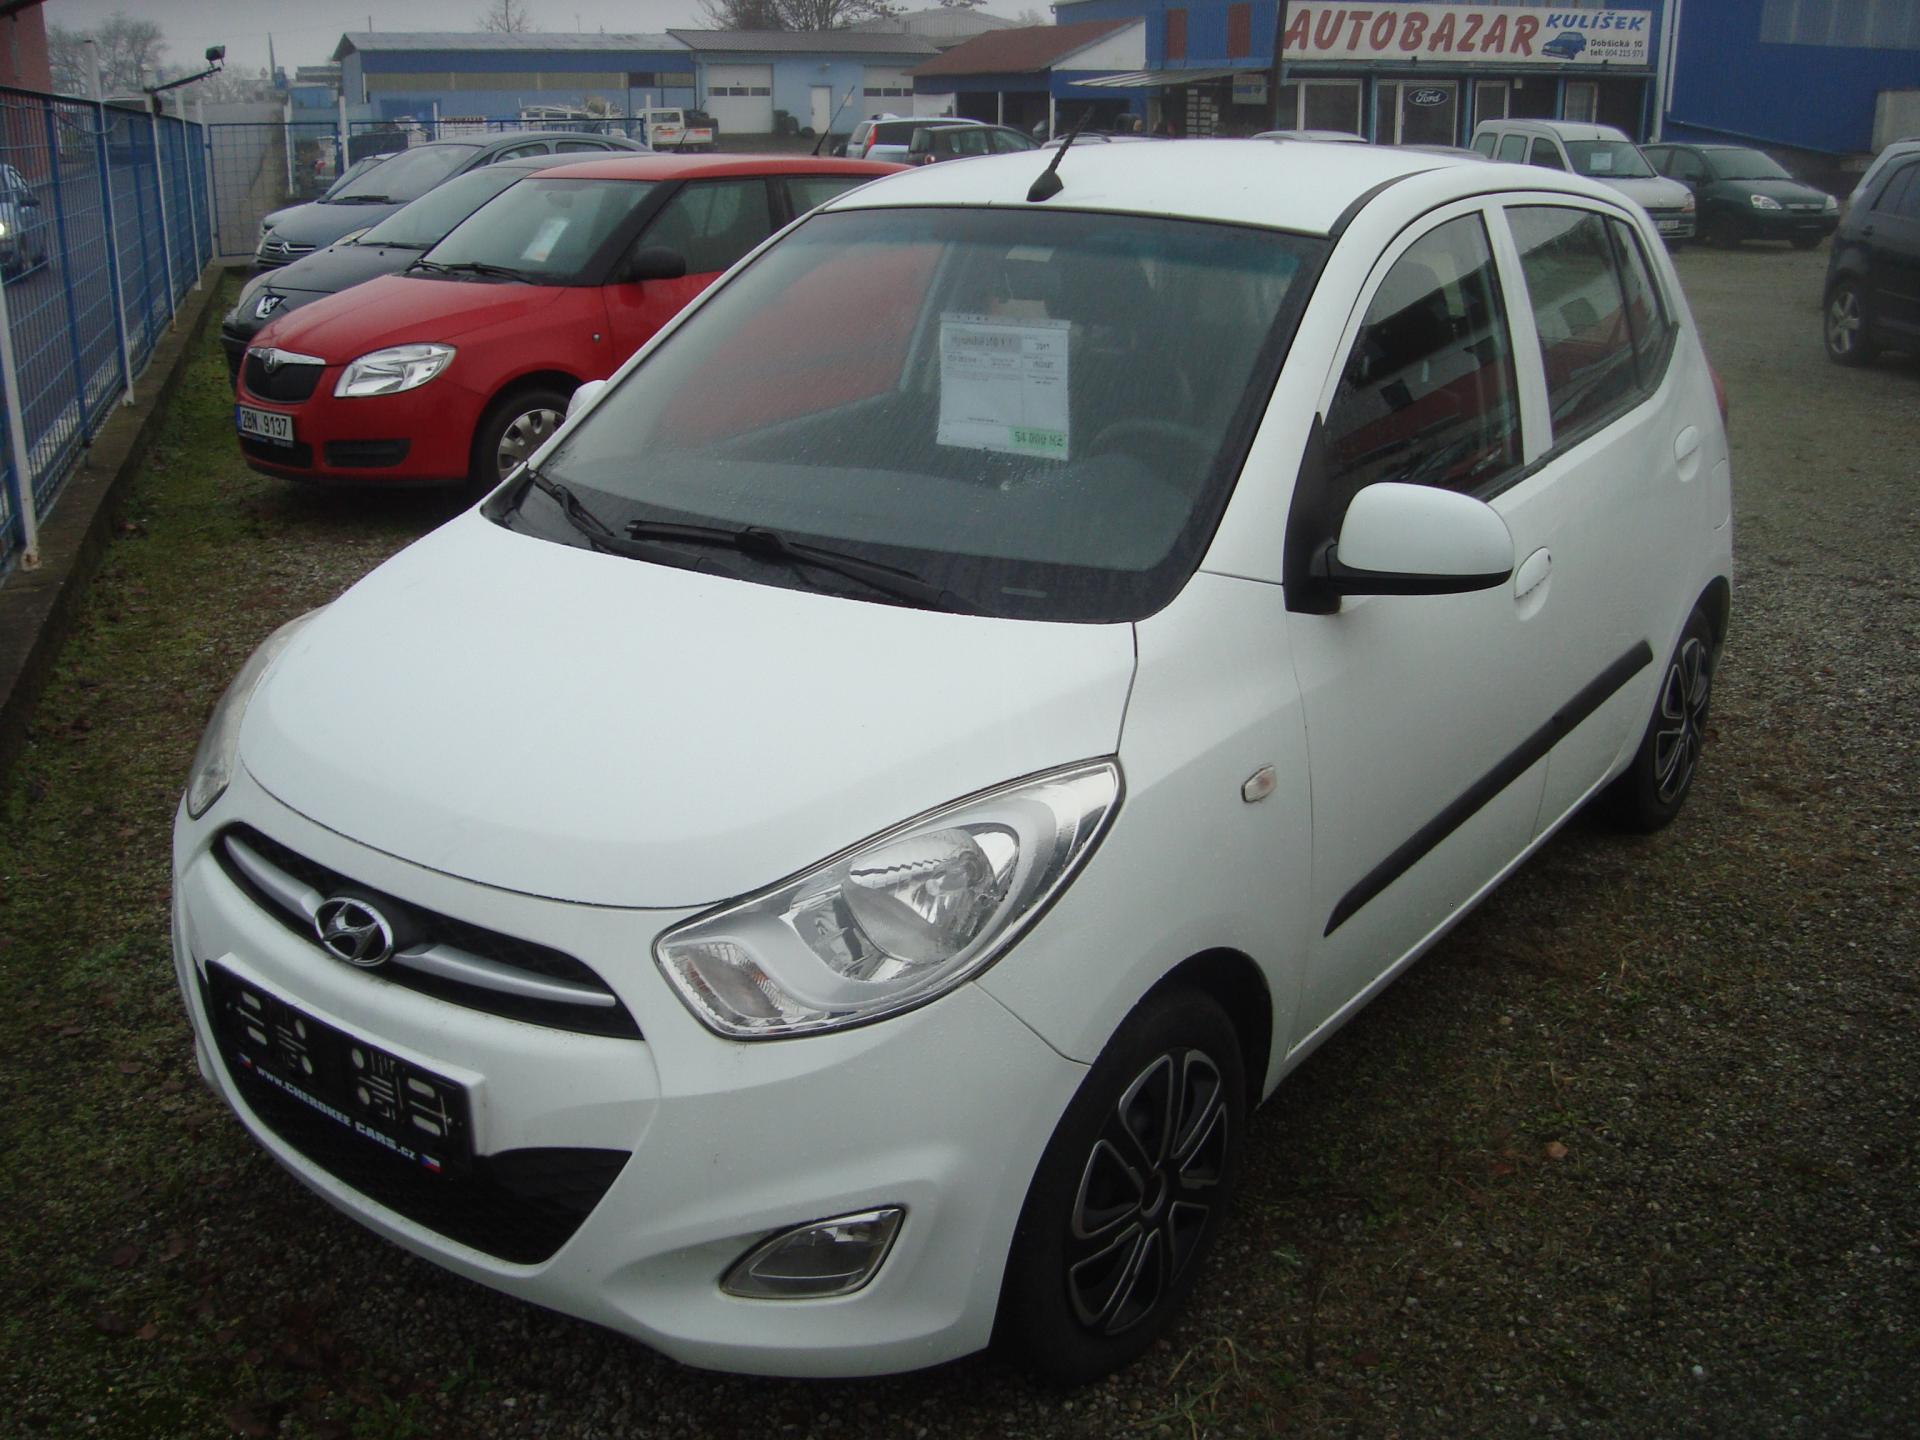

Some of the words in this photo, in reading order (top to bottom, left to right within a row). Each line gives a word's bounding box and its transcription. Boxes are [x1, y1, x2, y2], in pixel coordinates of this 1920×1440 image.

[1545, 11, 1645, 31] KULÍŠEK
[1283, 8, 1540, 57] AUTOBAZAR
[1415, 90, 1441, 103] Ford
